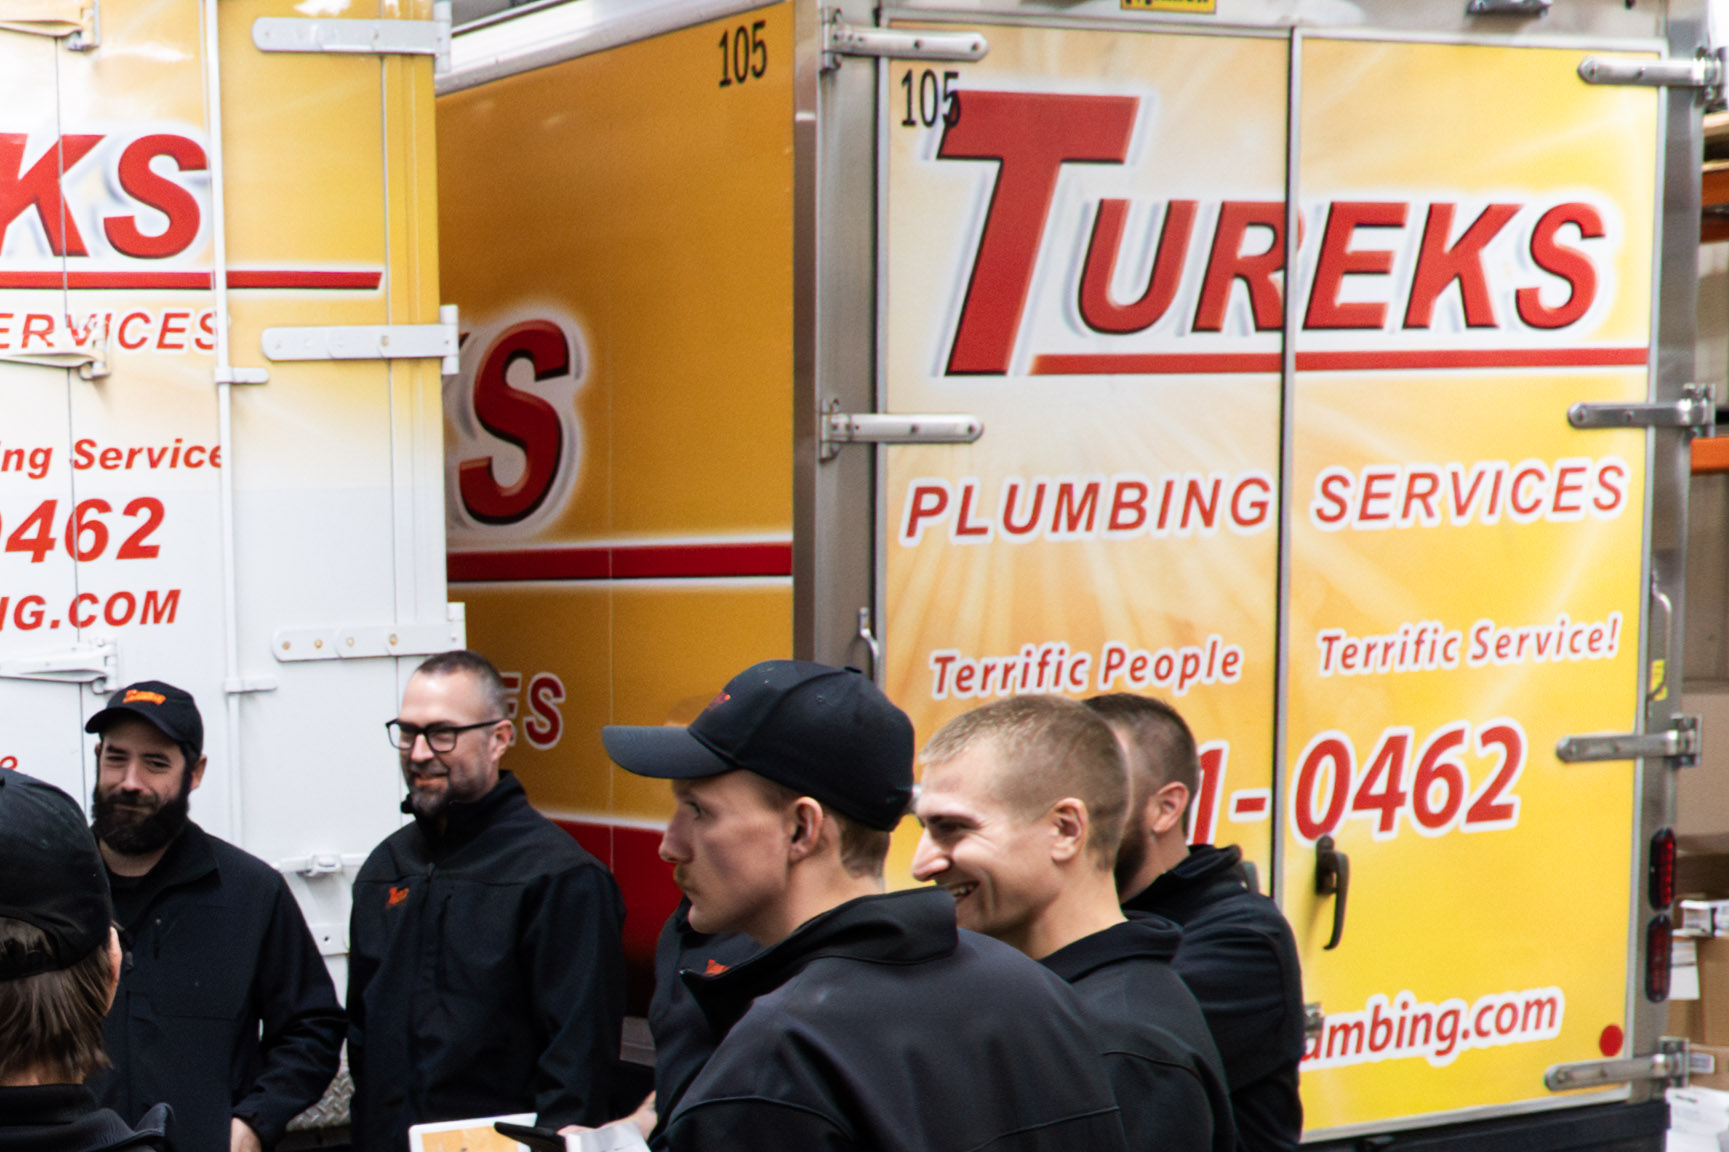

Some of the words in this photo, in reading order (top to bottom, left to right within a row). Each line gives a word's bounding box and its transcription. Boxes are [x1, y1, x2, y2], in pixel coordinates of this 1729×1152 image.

[718, 20, 768, 88] 105
[901, 69, 961, 128] 105
[937, 89, 1606, 377] TUREKS
[72, 437, 223, 471] Service
[906, 477, 1271, 538] PLUMBING
[1315, 464, 1624, 523] SERVICES
[933, 648, 1087, 694] Terrific
[1103, 640, 1240, 690] People
[1321, 627, 1458, 671] Terrific
[1471, 618, 1619, 661] Service!
